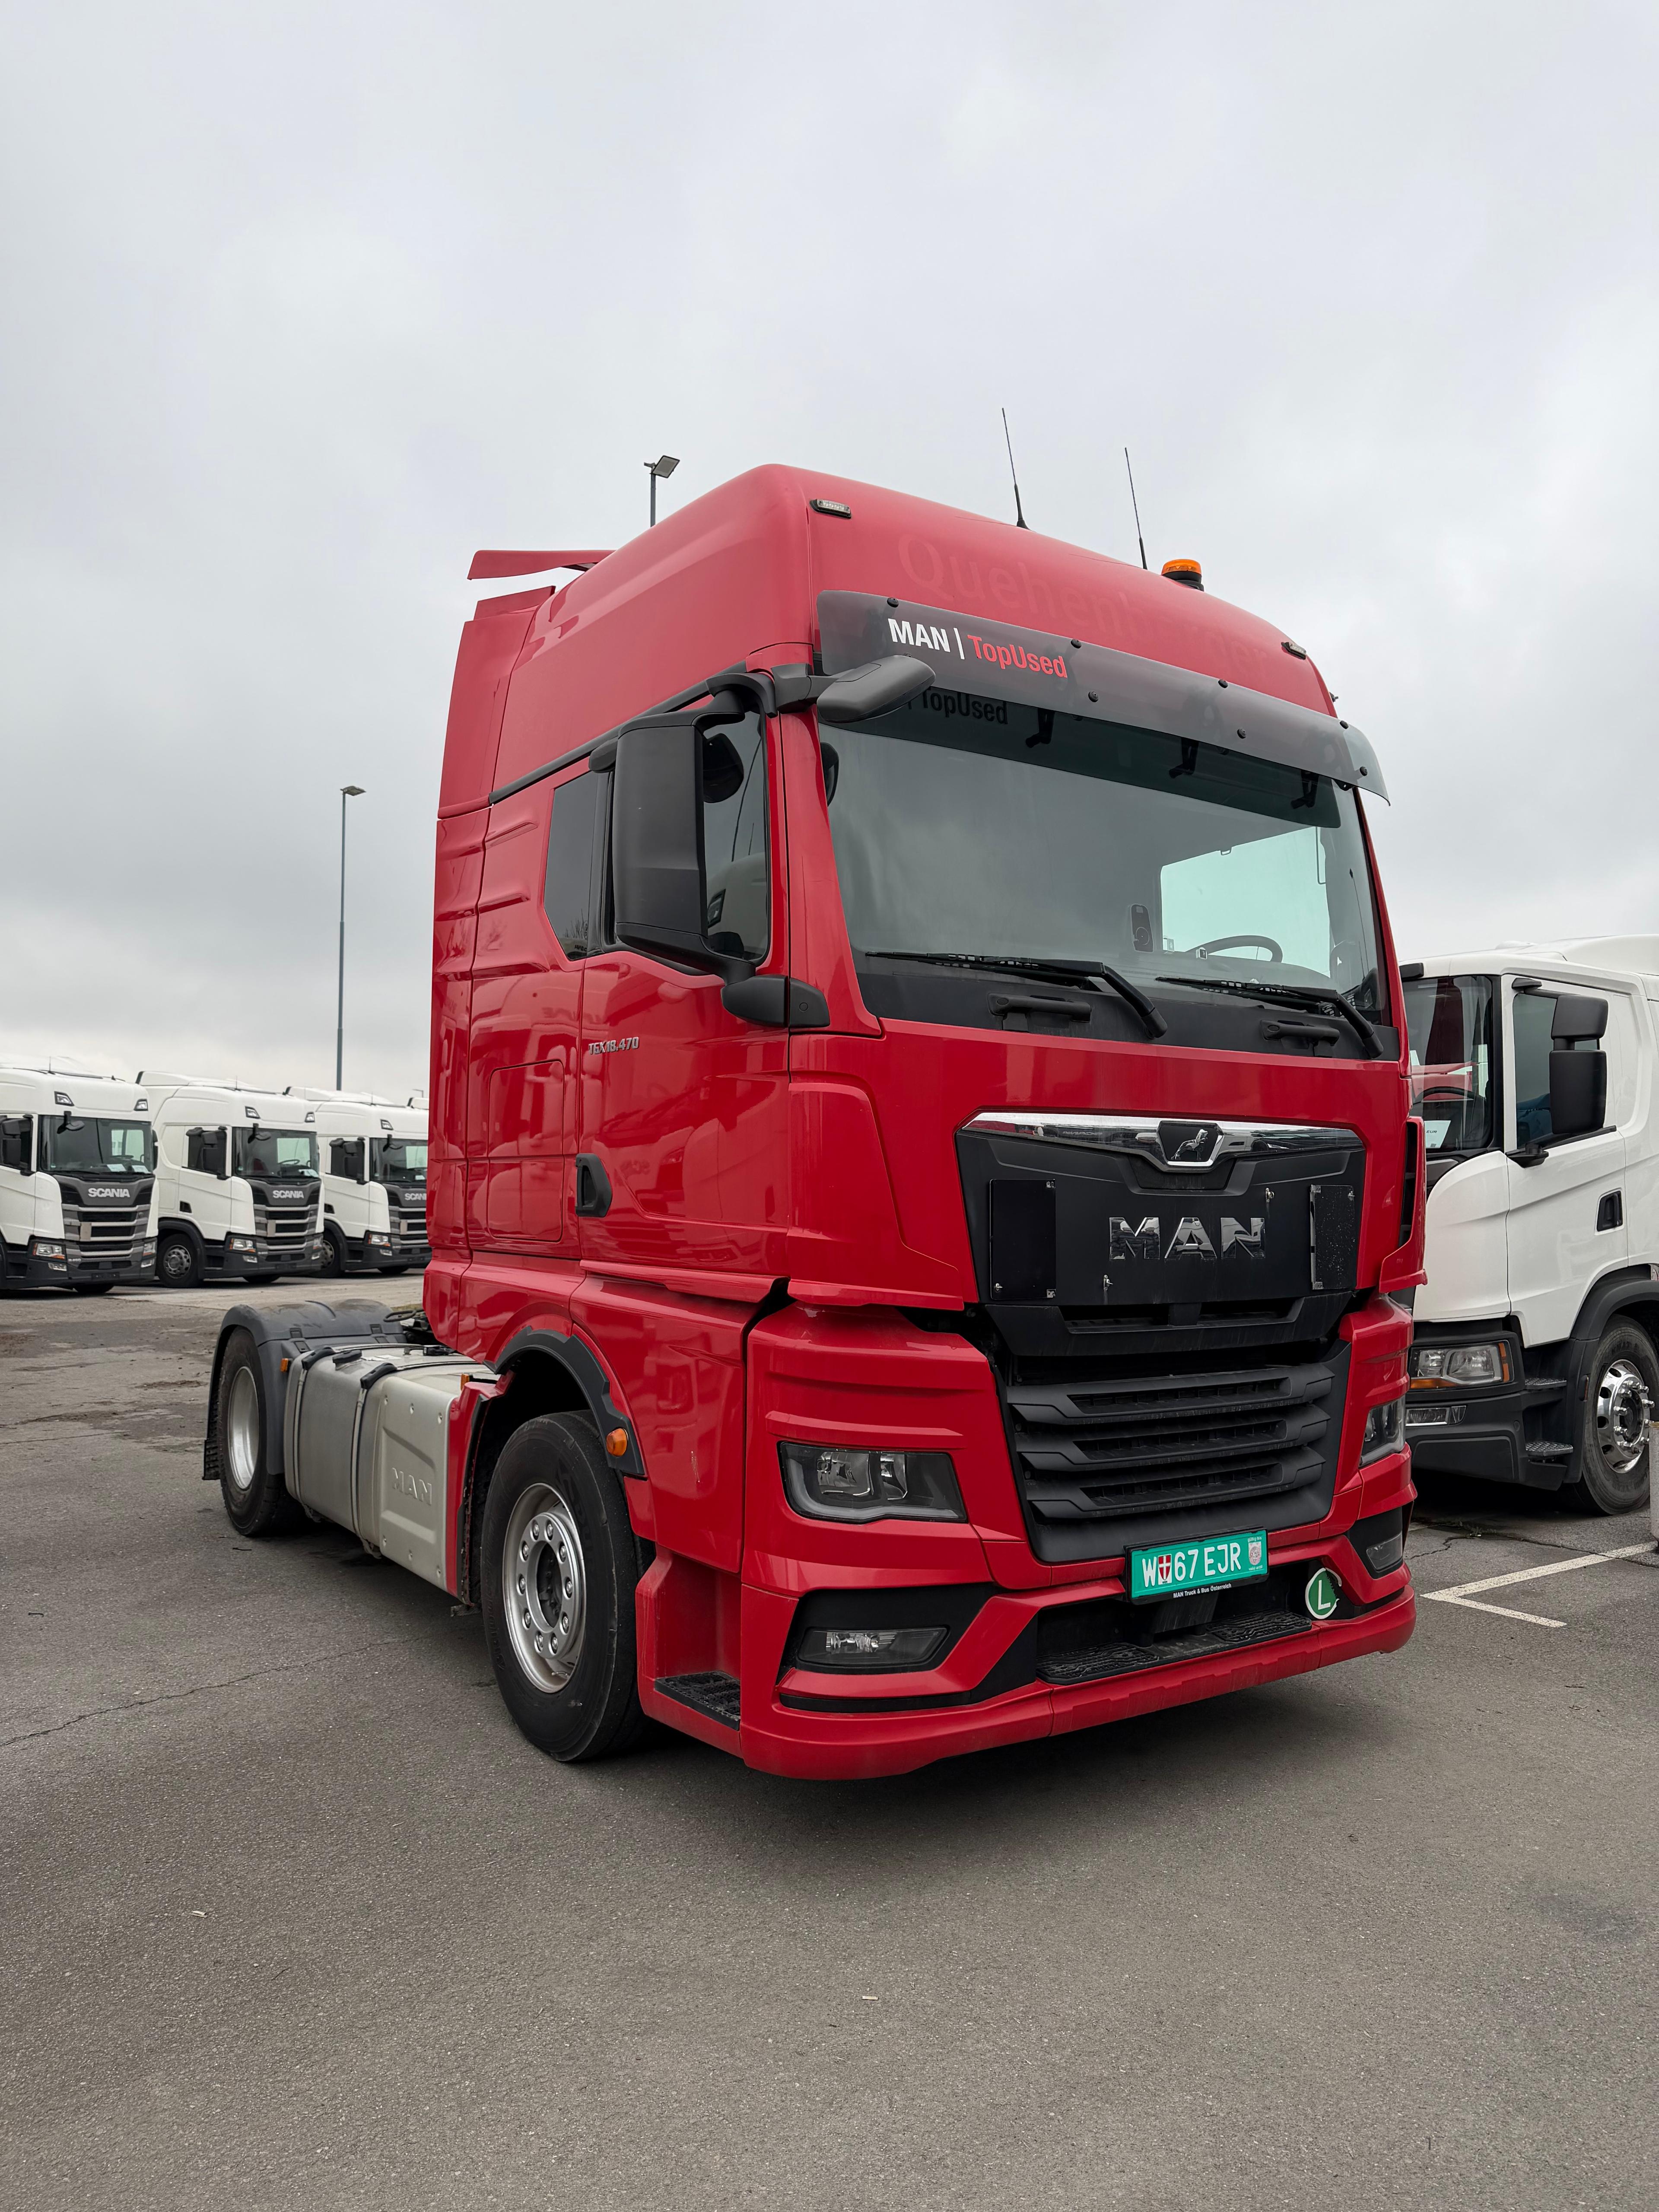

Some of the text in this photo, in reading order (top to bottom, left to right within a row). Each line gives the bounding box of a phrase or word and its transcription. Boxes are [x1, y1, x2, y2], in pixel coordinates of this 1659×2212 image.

[888, 618, 1068, 678] MAN TopUsed
[88, 1188, 130, 1198] SCANIA
[273, 1190, 304, 1198] SCANIA
[1109, 1217, 1265, 1260] MAN
[392, 1467, 432, 1506] MAN
[1142, 1556, 1157, 1587] W
[1210, 1583, 1232, 1591] Österreich
[1318, 1580, 1331, 1610] L
